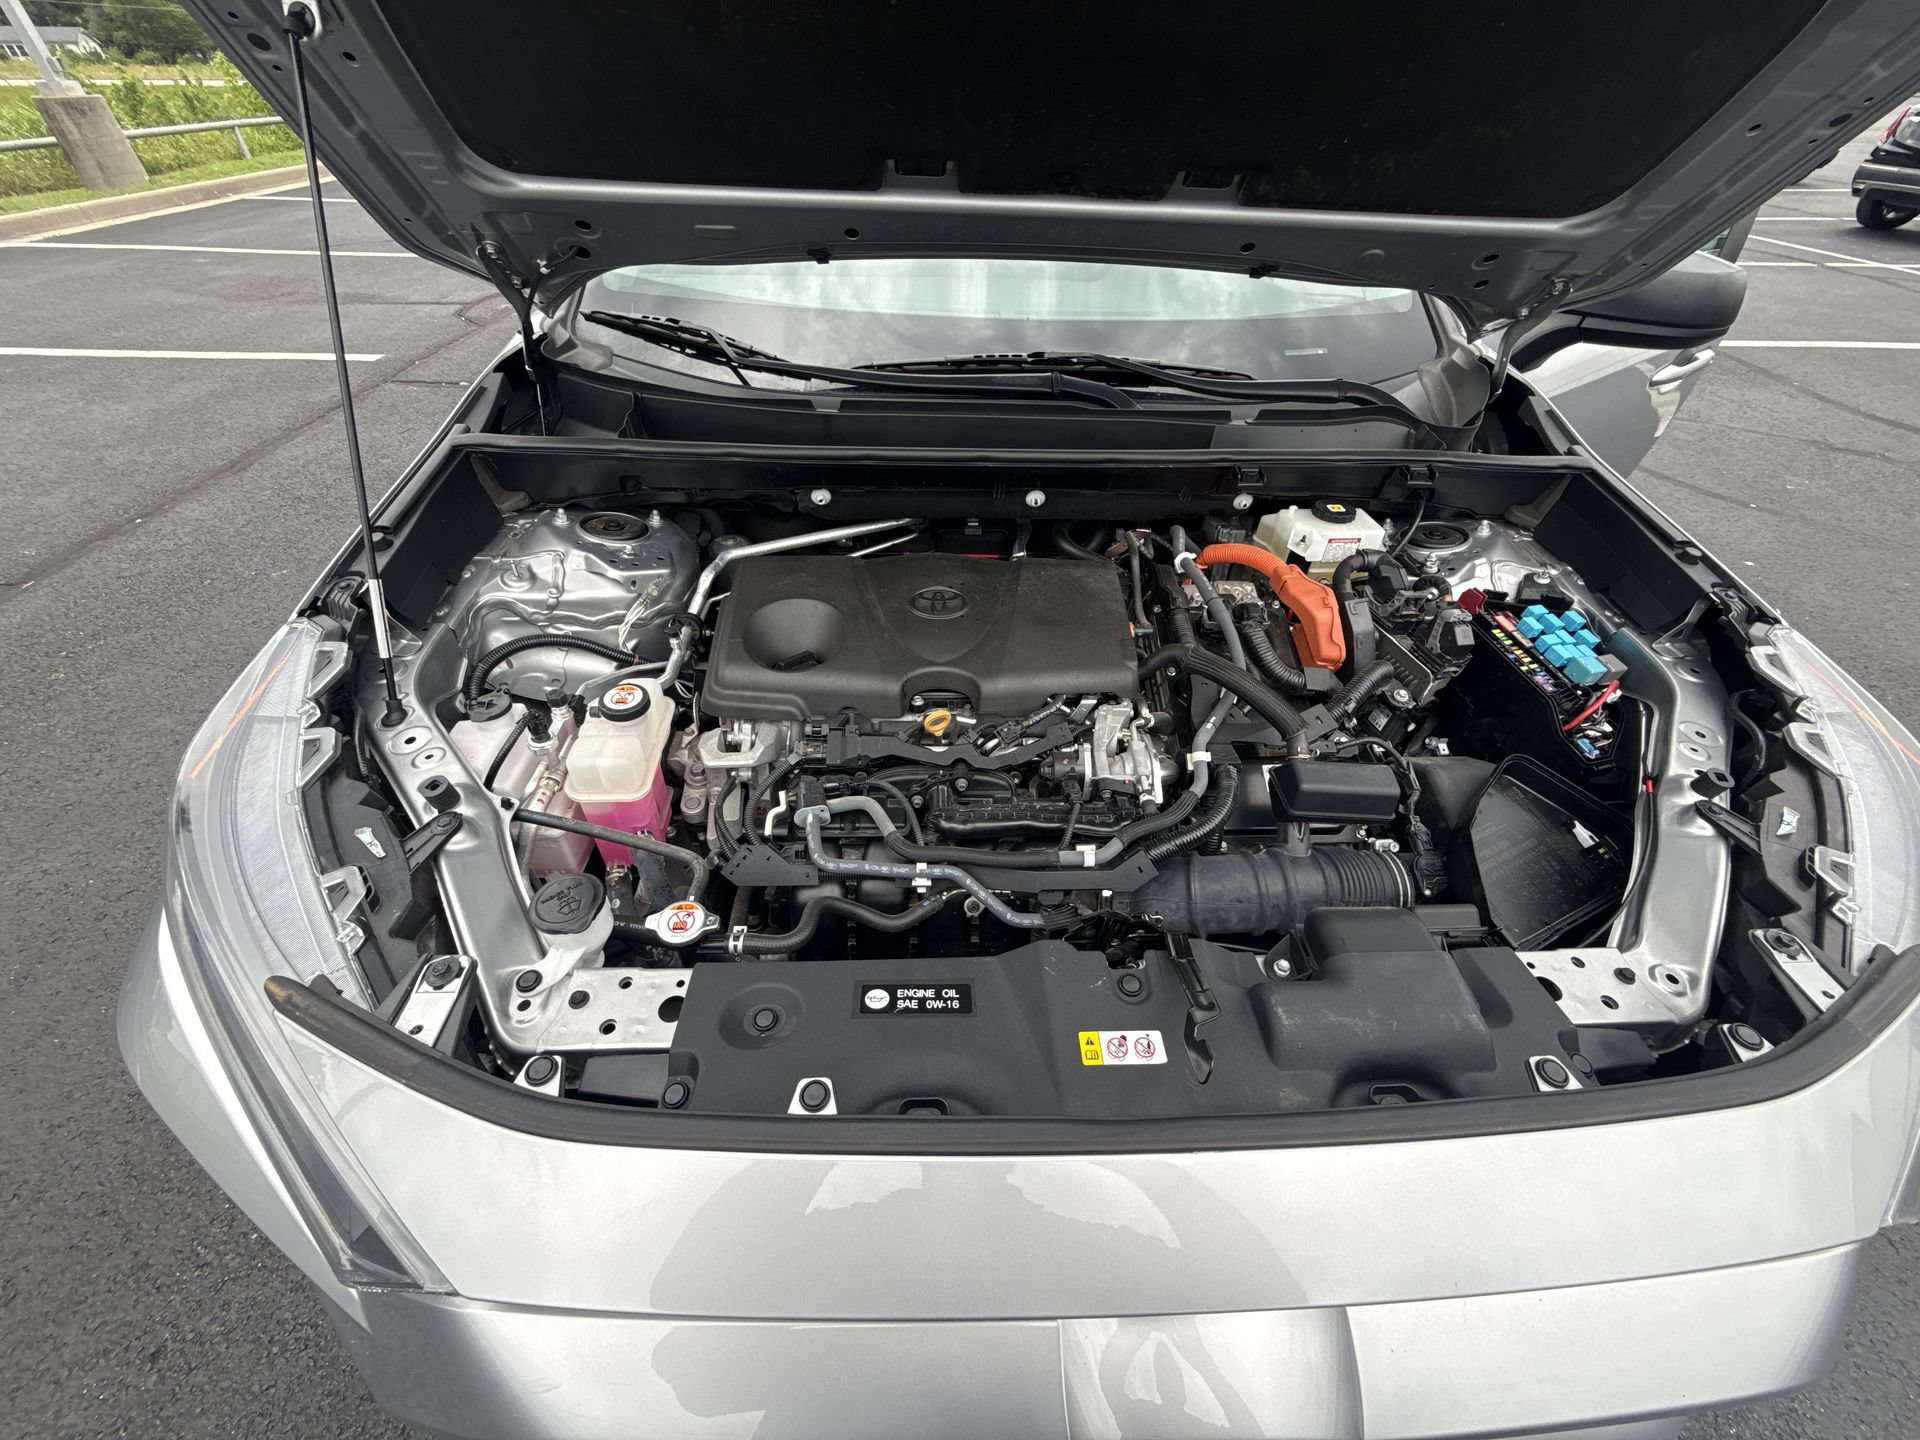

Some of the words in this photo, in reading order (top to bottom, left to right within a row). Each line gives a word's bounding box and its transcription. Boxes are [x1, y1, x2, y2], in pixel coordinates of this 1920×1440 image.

[540, 890, 565, 905] WASHER
[897, 988, 936, 998] ENGINE
[942, 988, 960, 998] OIL
[897, 999, 919, 1009] SAE
[925, 999, 960, 1009] 0W-16
